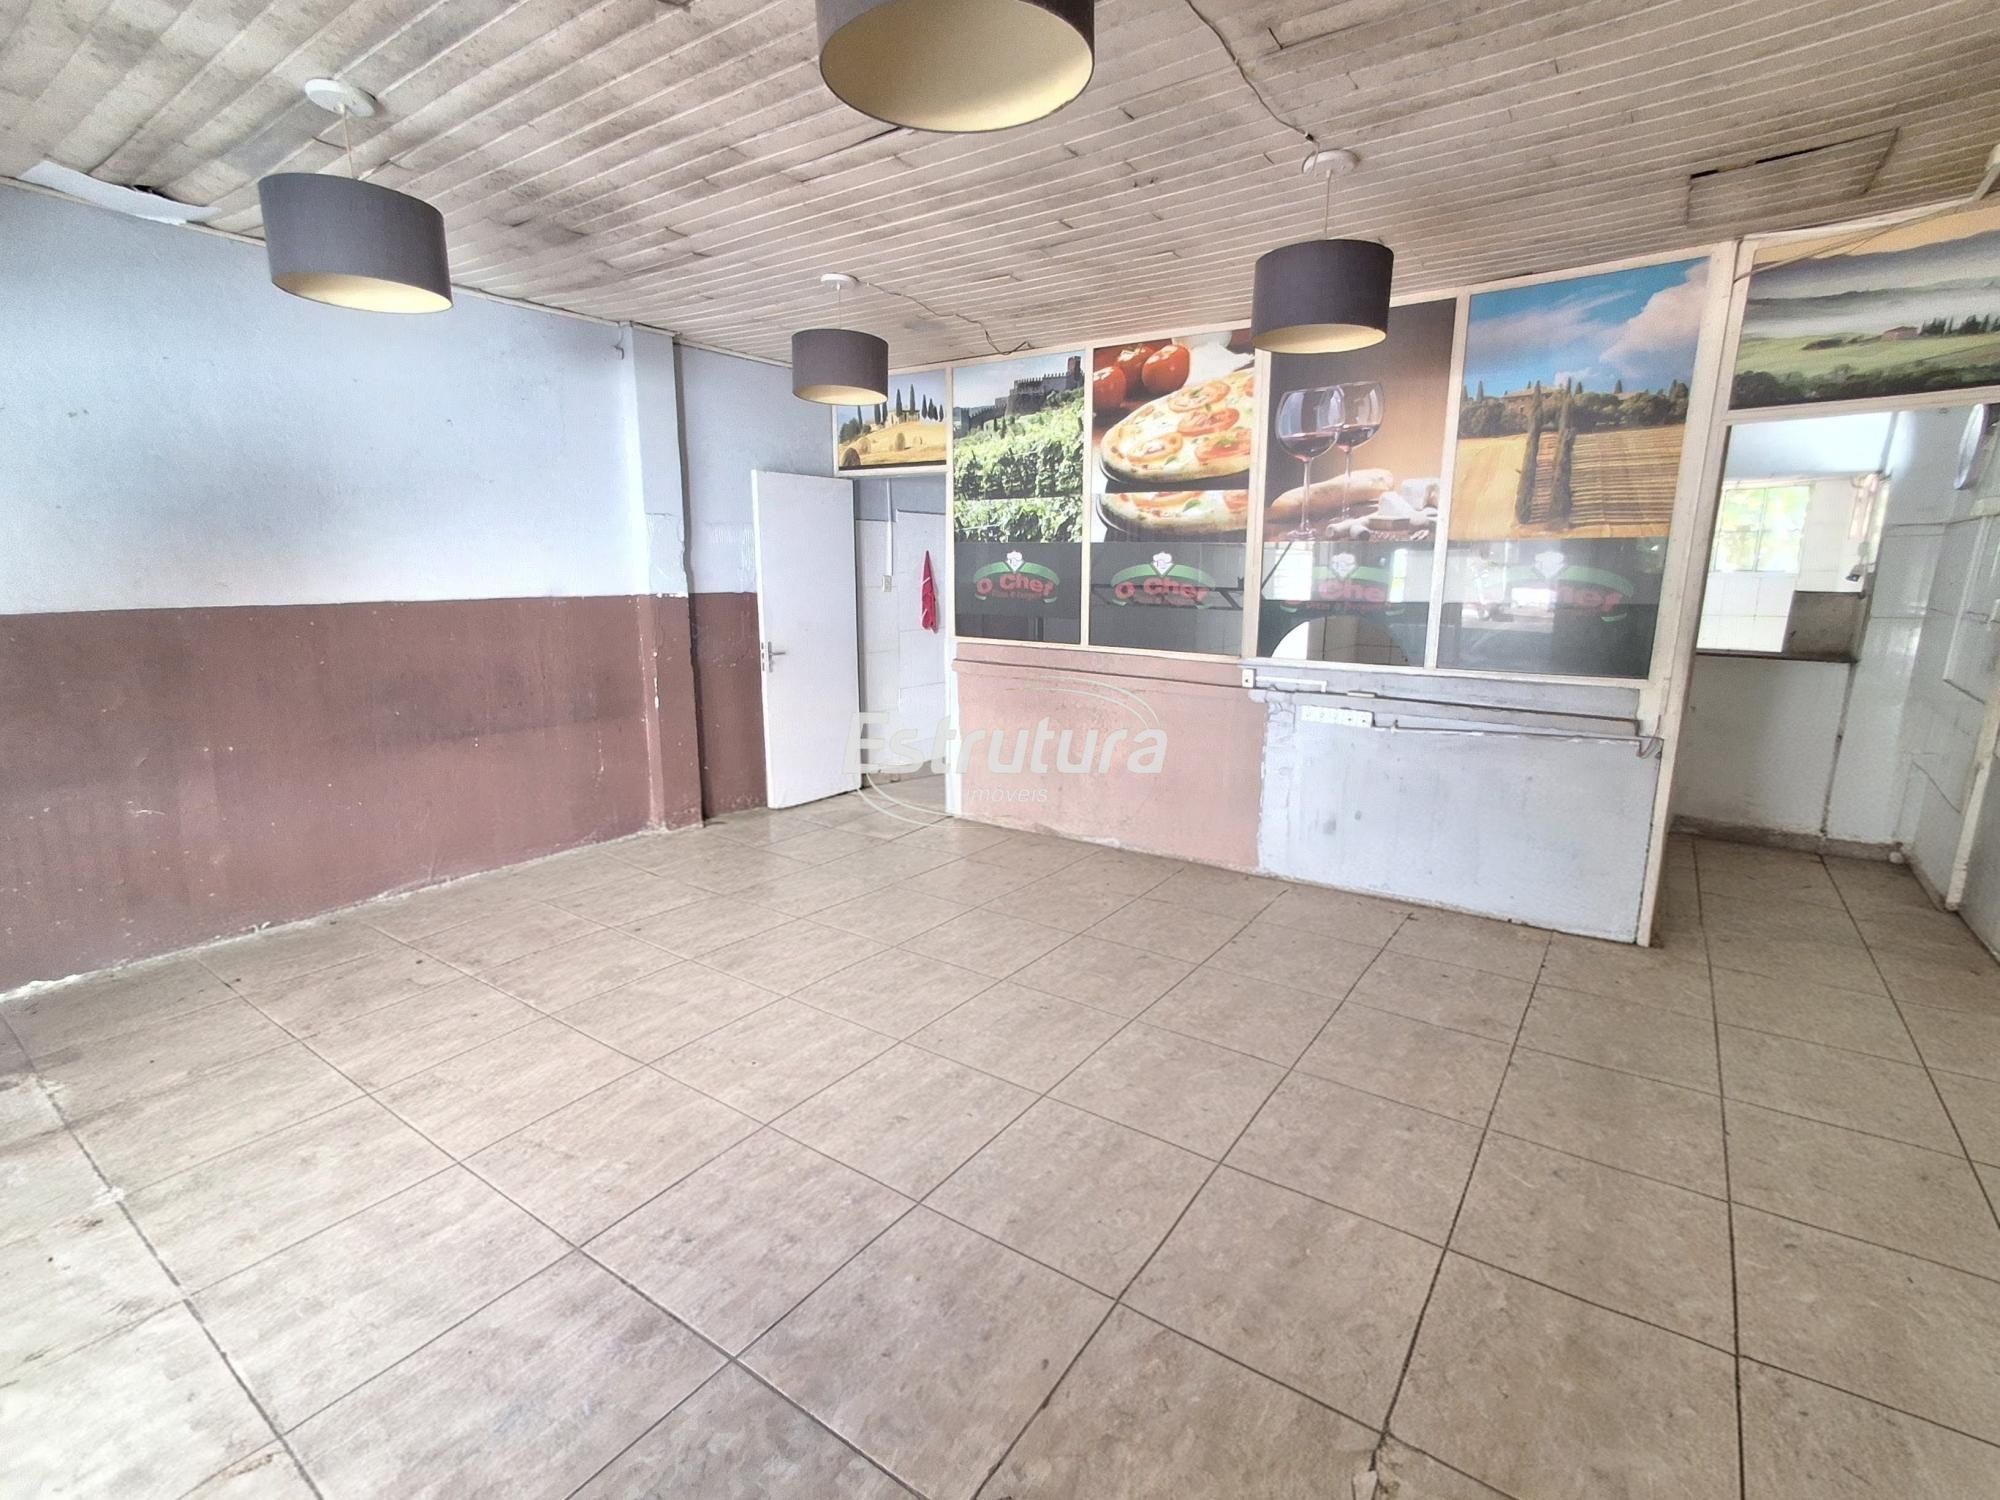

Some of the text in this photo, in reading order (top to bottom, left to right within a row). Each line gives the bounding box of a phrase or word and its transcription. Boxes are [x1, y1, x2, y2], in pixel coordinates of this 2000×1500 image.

[976, 573, 1054, 596] O Chef
[1115, 581, 1136, 599] O
[1318, 578, 1391, 605] Che
